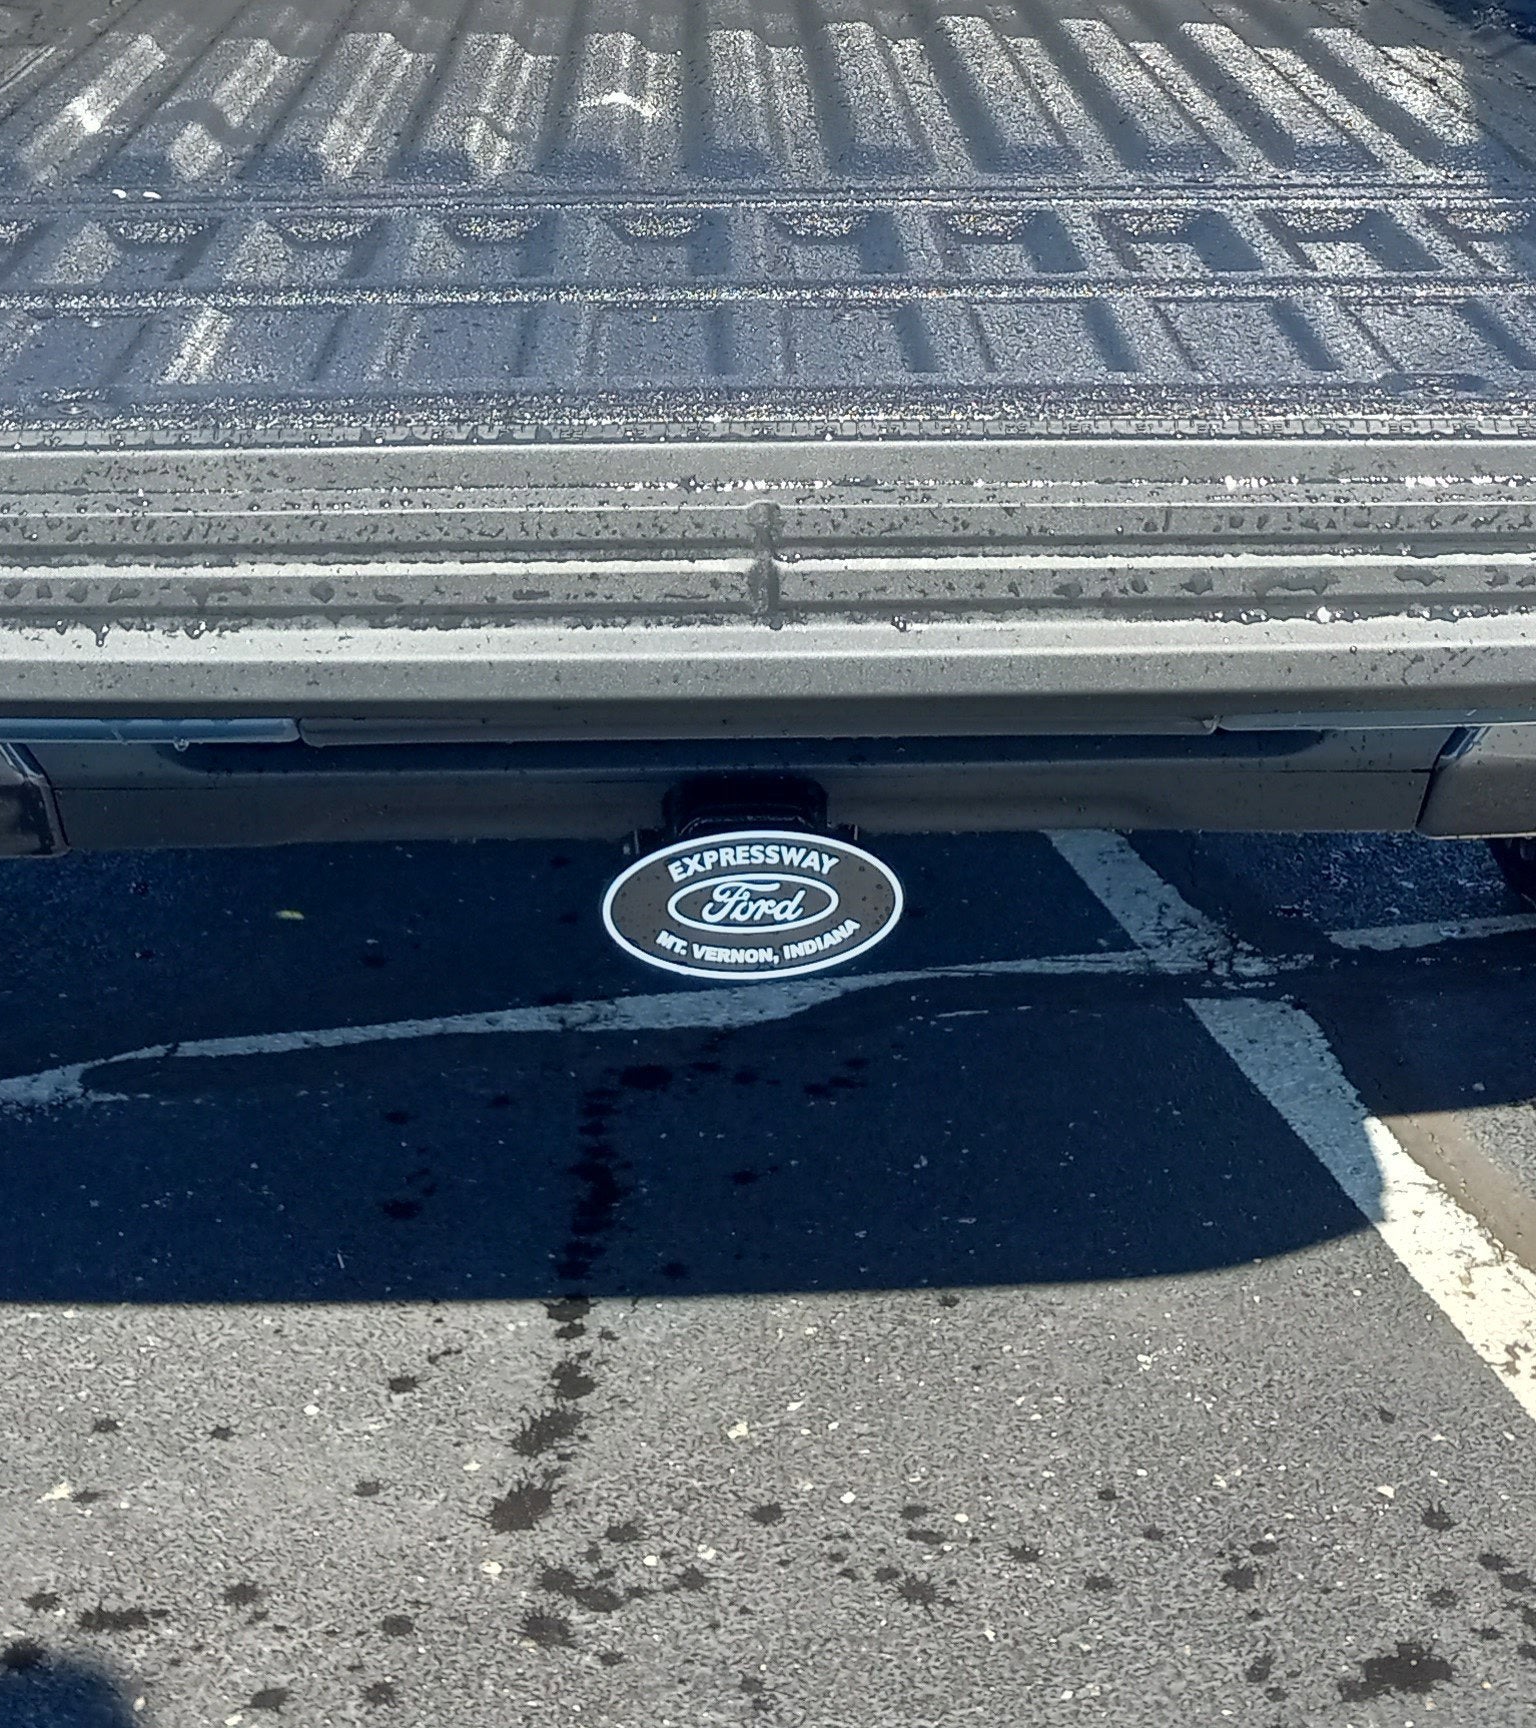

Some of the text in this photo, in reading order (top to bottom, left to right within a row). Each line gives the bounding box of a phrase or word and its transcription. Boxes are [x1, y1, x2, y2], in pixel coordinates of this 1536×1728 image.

[667, 844, 840, 883] EXPRESSWAY
[701, 880, 807, 924] Ford
[655, 917, 862, 965] MT. VERNON, INDIANA
